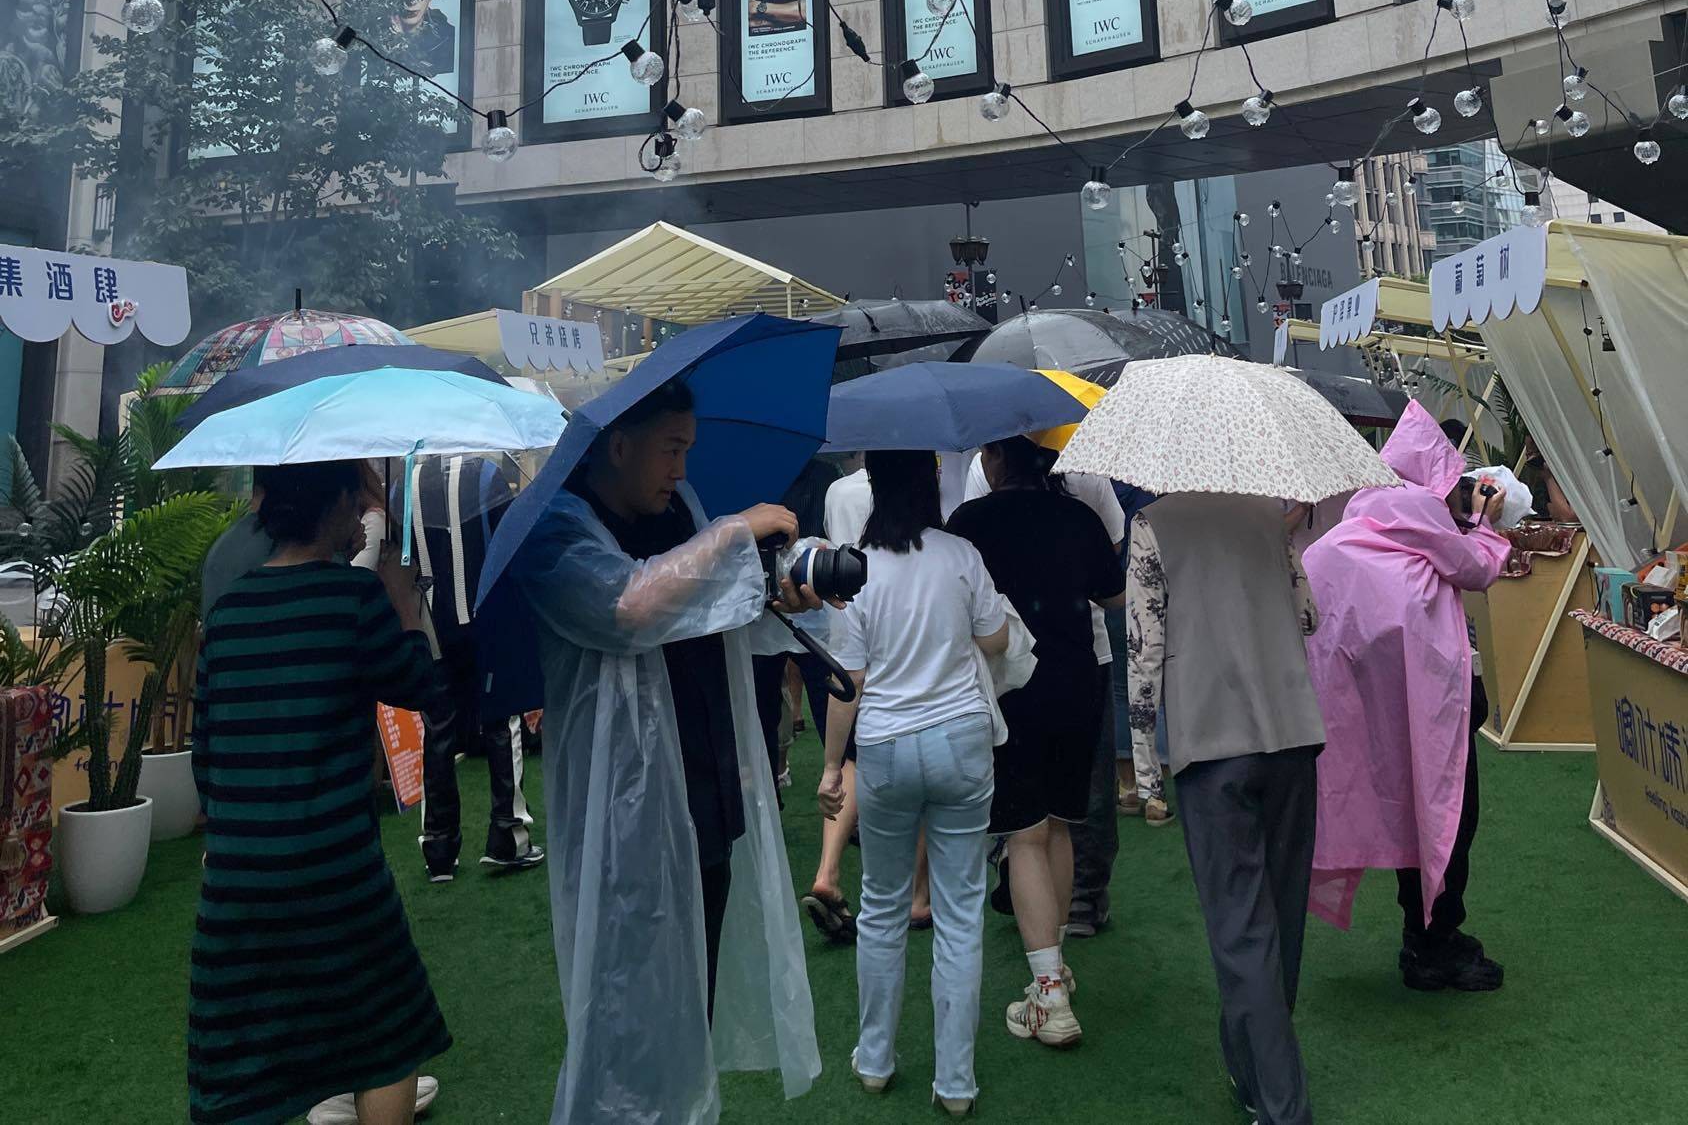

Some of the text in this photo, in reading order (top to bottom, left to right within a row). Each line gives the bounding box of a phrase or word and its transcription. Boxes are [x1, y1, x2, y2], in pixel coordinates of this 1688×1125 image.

[1094, 16, 1120, 35] IWC
[1085, 31, 1131, 46] SCHAFFHAUSEN
[929, 47, 955, 62] IWC
[922, 60, 964, 71] SCHAFFHAUSEN
[766, 72, 792, 86] IWC
[756, 86, 802, 94] SCHAFFHAUS
[584, 92, 610, 105] IWC
[575, 105, 618, 113] SCHAFFHAUSEN
